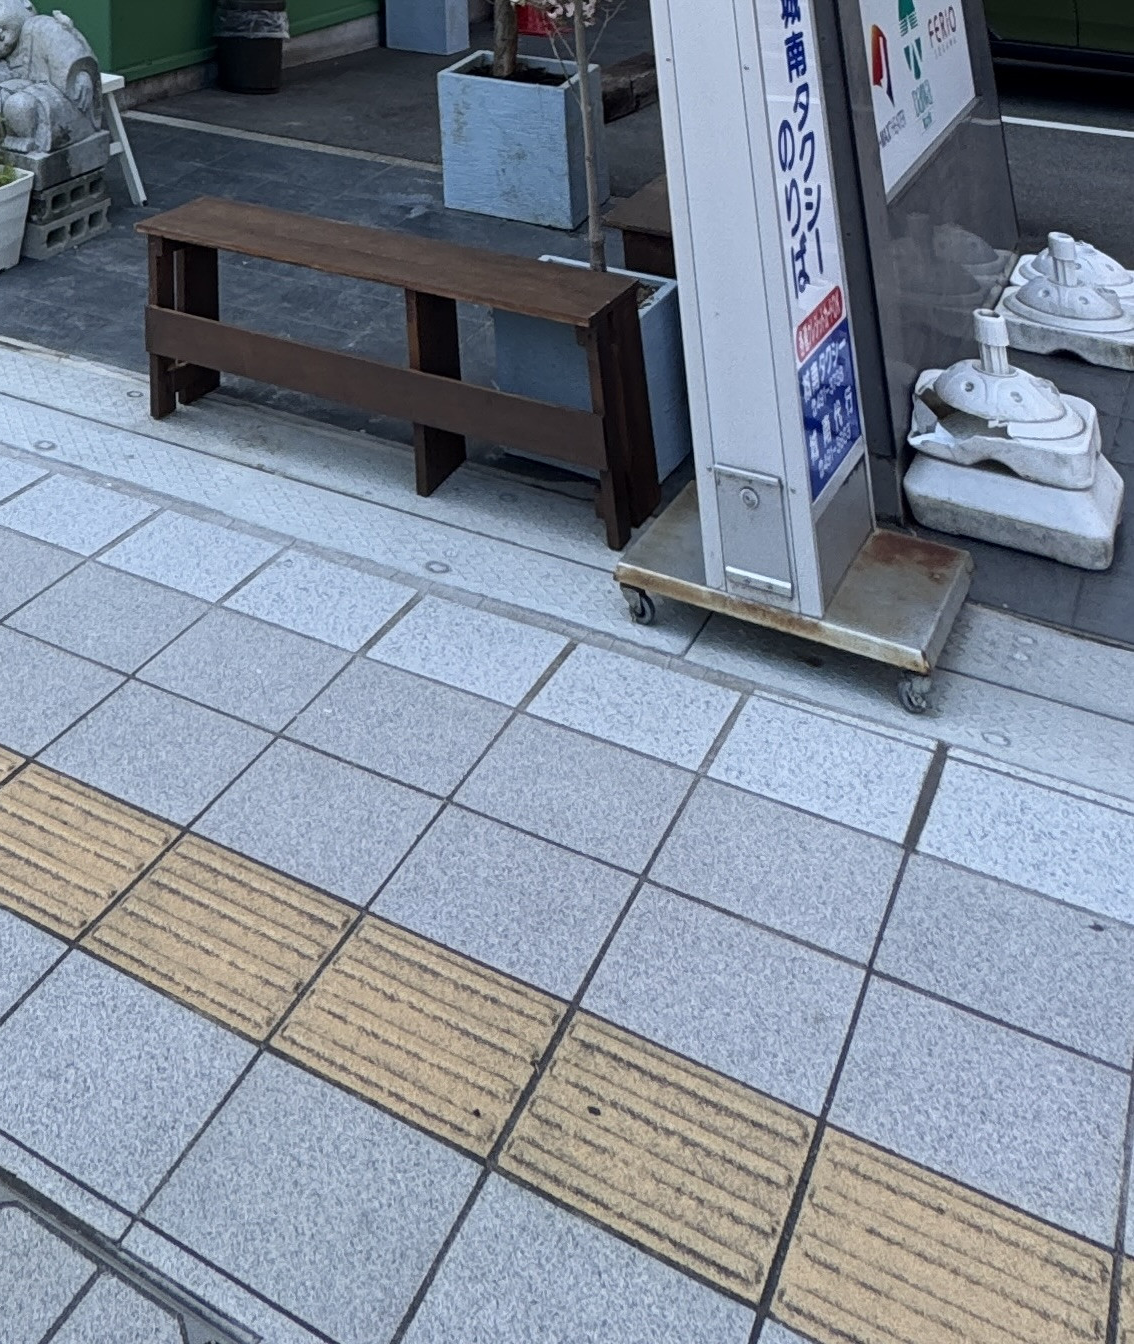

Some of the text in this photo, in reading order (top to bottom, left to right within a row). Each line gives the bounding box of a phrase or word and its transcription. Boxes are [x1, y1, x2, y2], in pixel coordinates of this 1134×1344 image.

[928, 5, 957, 49] FERIO
[778, 119, 810, 300] のりば
